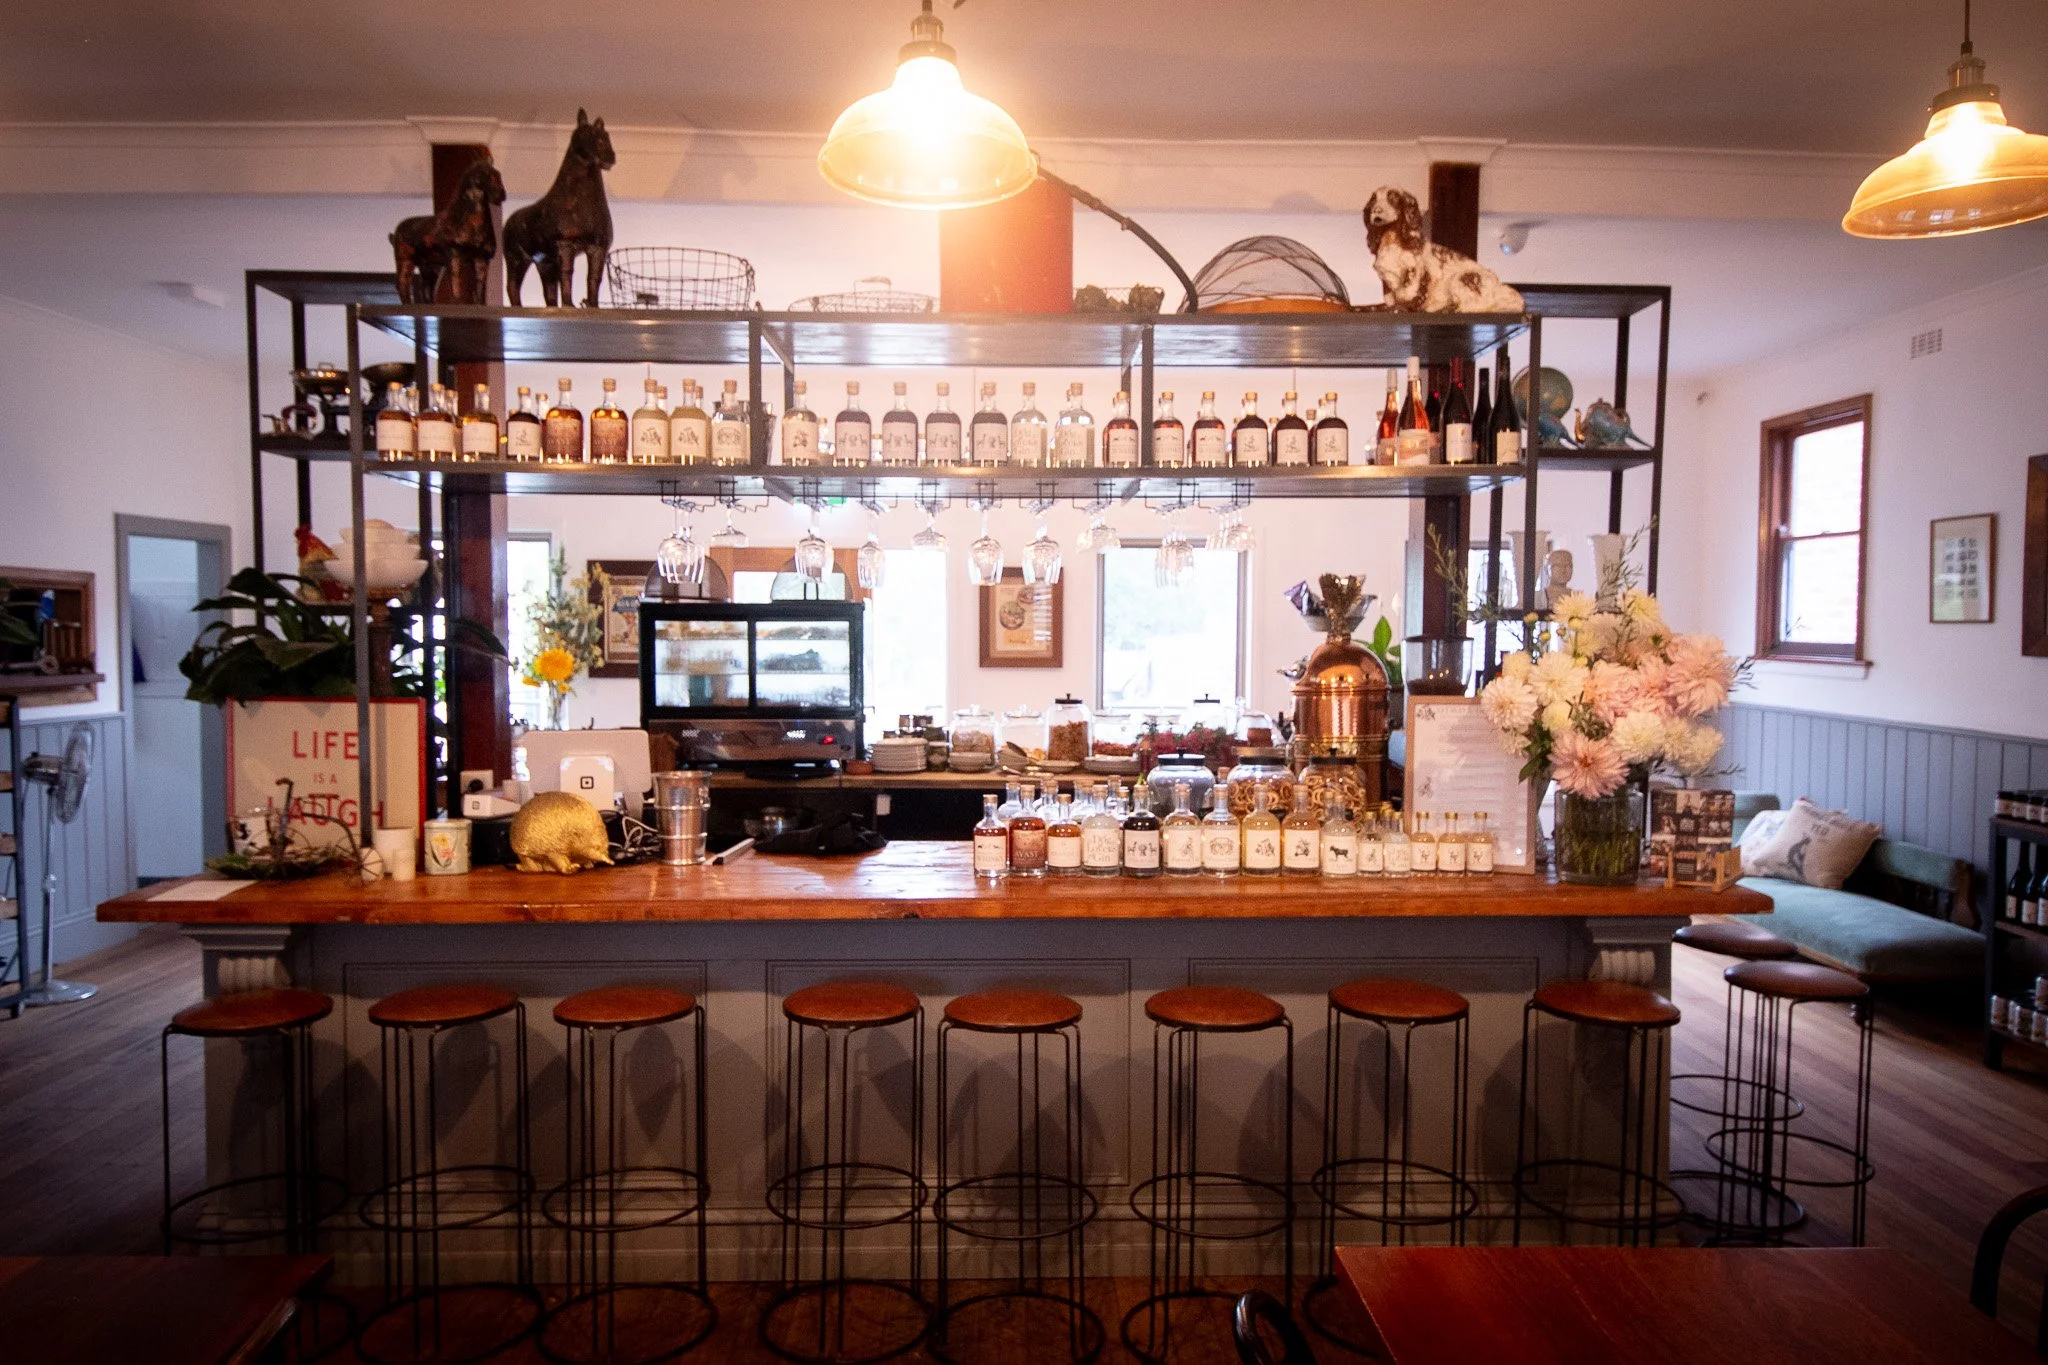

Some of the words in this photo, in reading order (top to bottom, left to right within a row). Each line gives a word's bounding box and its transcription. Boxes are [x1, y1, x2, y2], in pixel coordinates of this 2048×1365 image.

[292, 730, 360, 760] LIFE
[314, 773, 324, 784] IS
[329, 773, 337, 784] A
